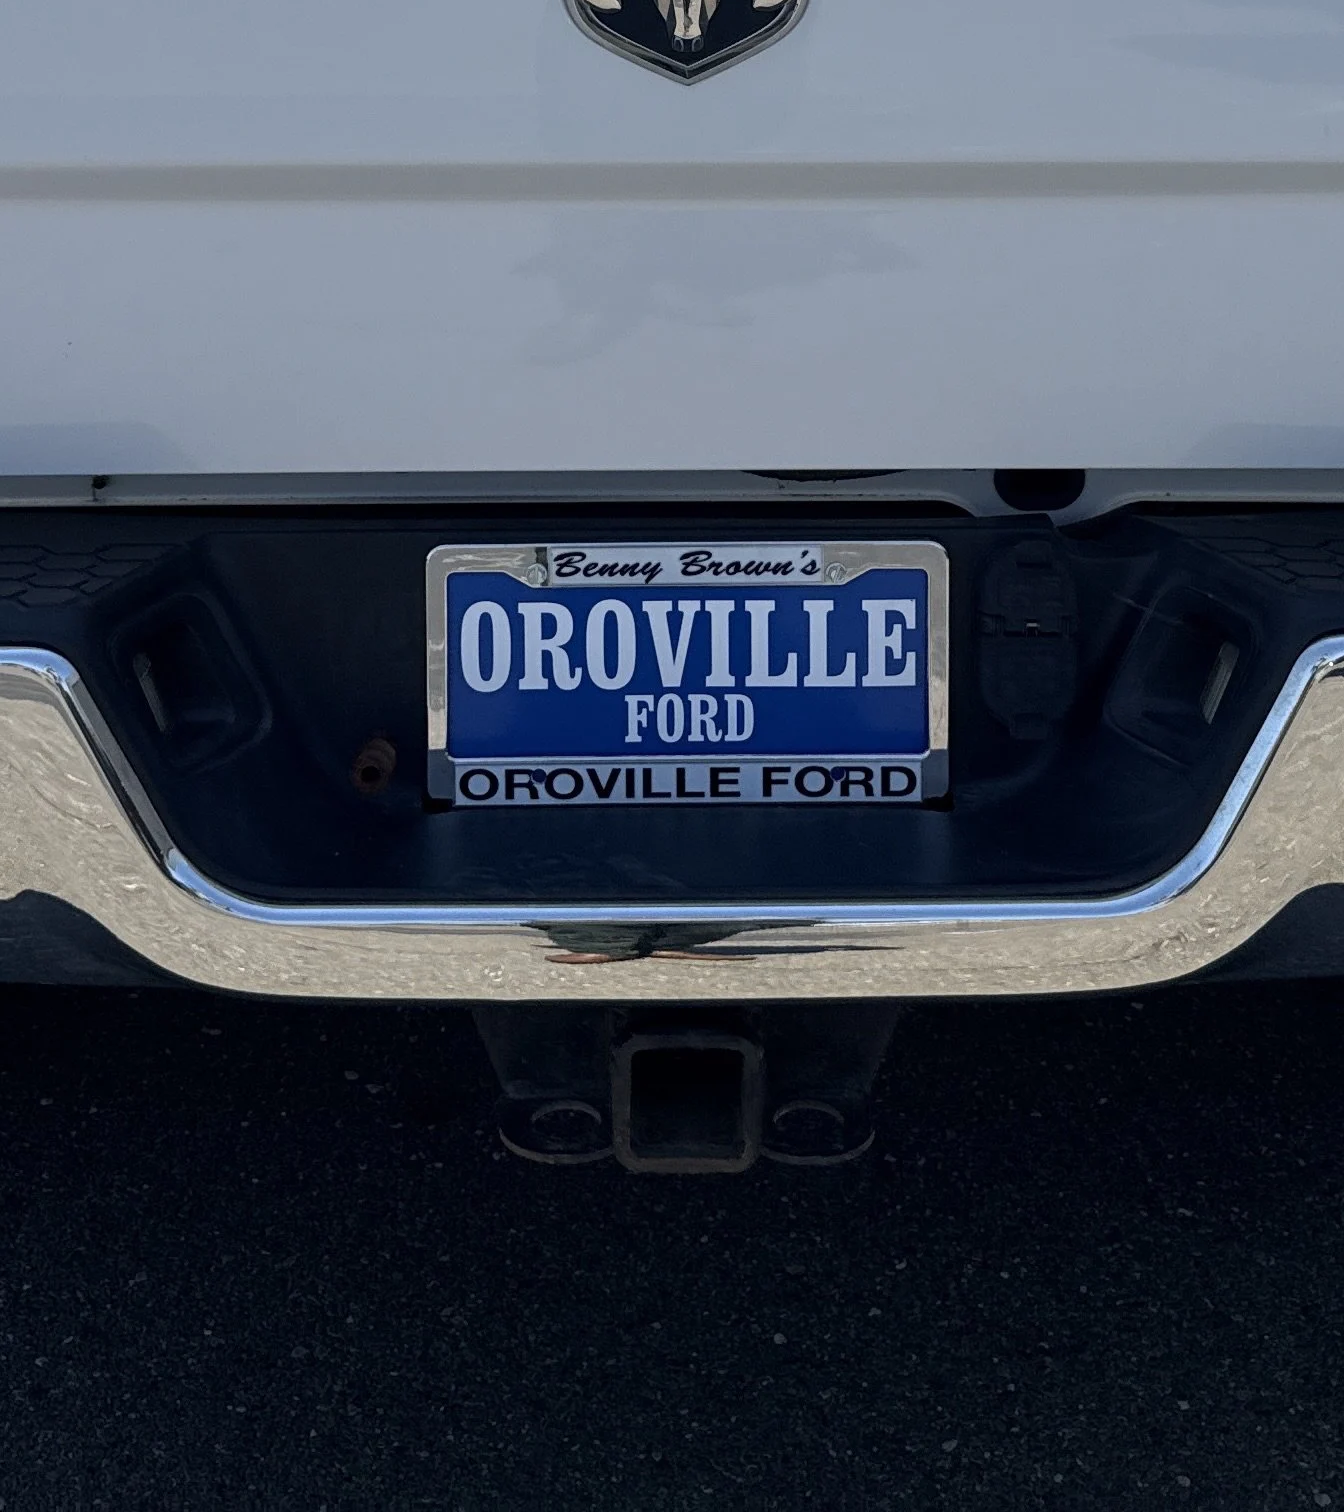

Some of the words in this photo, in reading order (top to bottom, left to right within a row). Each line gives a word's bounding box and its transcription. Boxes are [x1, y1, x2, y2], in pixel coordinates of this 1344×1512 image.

[554, 550, 662, 584] Benny
[678, 549, 822, 580] Brown's
[460, 598, 917, 693] OROVILLE
[624, 693, 755, 744] FORD
[458, 766, 741, 802] OROVILLE
[762, 765, 917, 799] FORD
